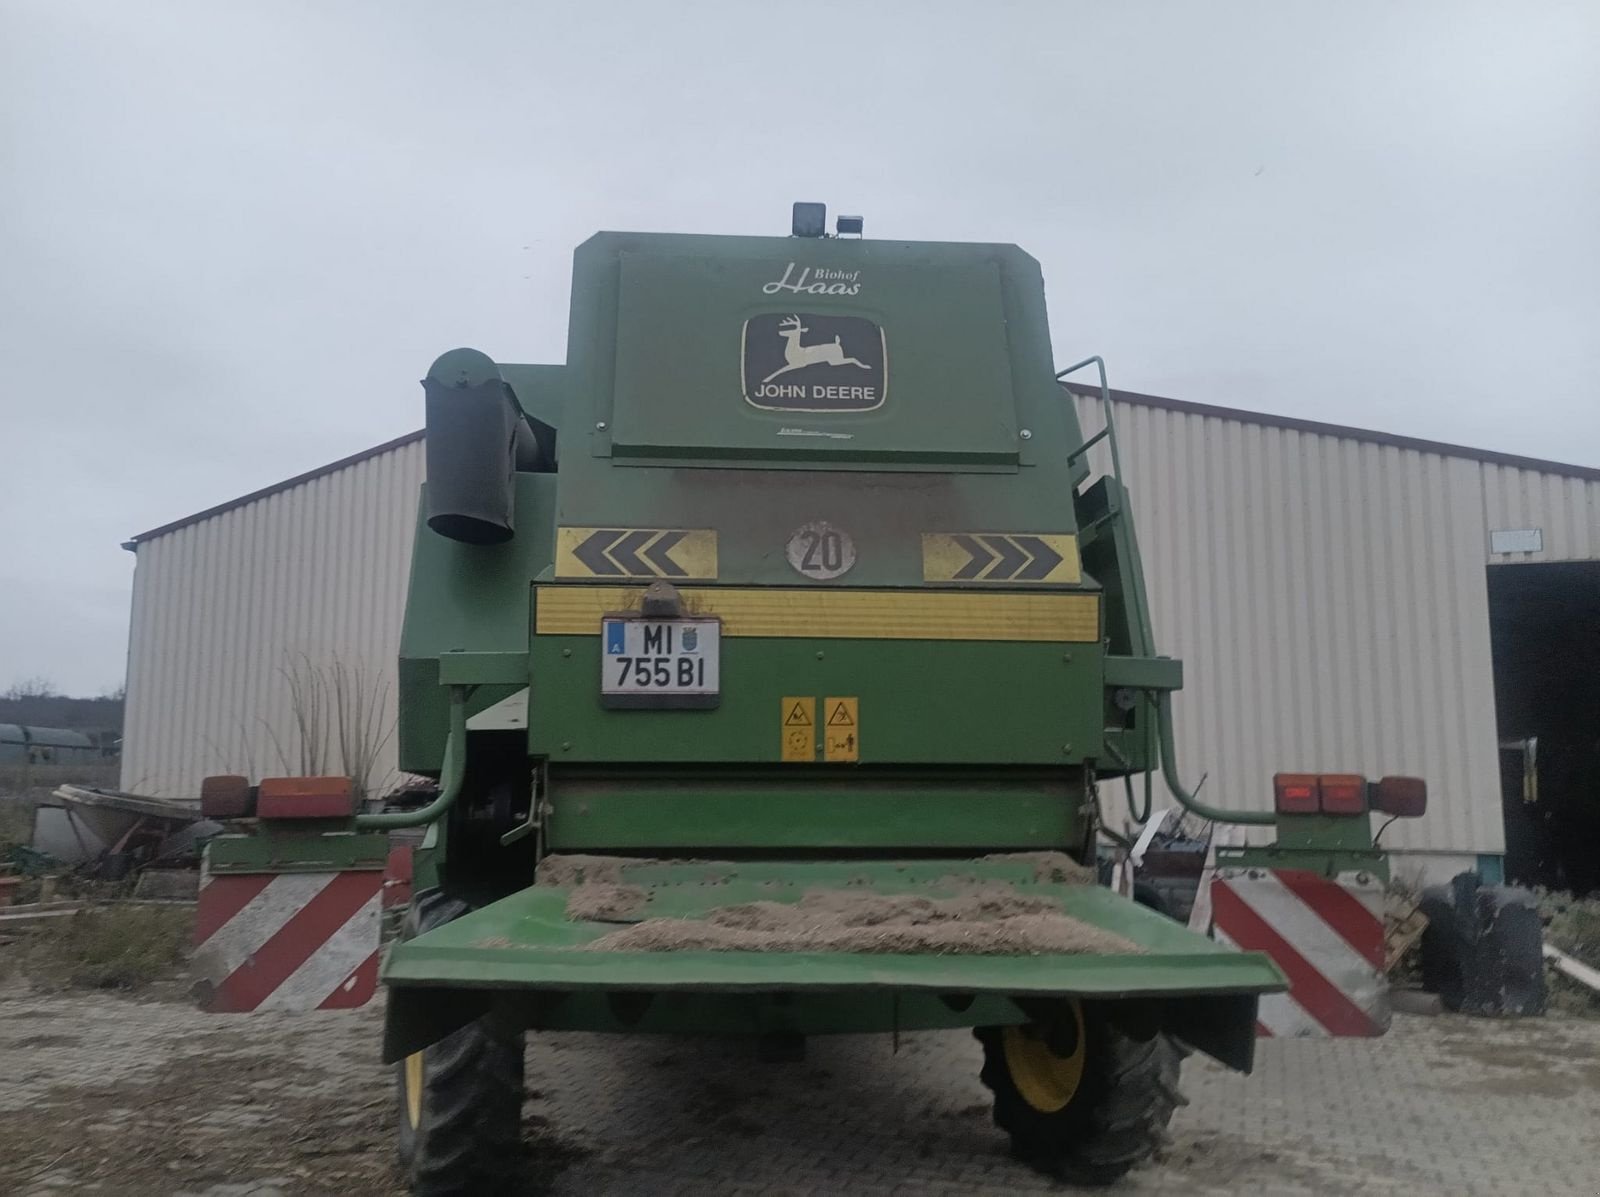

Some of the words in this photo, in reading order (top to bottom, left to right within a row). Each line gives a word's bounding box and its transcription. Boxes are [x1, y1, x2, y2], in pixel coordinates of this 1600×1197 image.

[762, 262, 861, 295] Haas
[815, 268, 860, 281] Biohof
[755, 384, 806, 398] JOHN
[813, 385, 875, 400] DEERE
[801, 531, 842, 571] 20
[643, 625, 672, 655] MI
